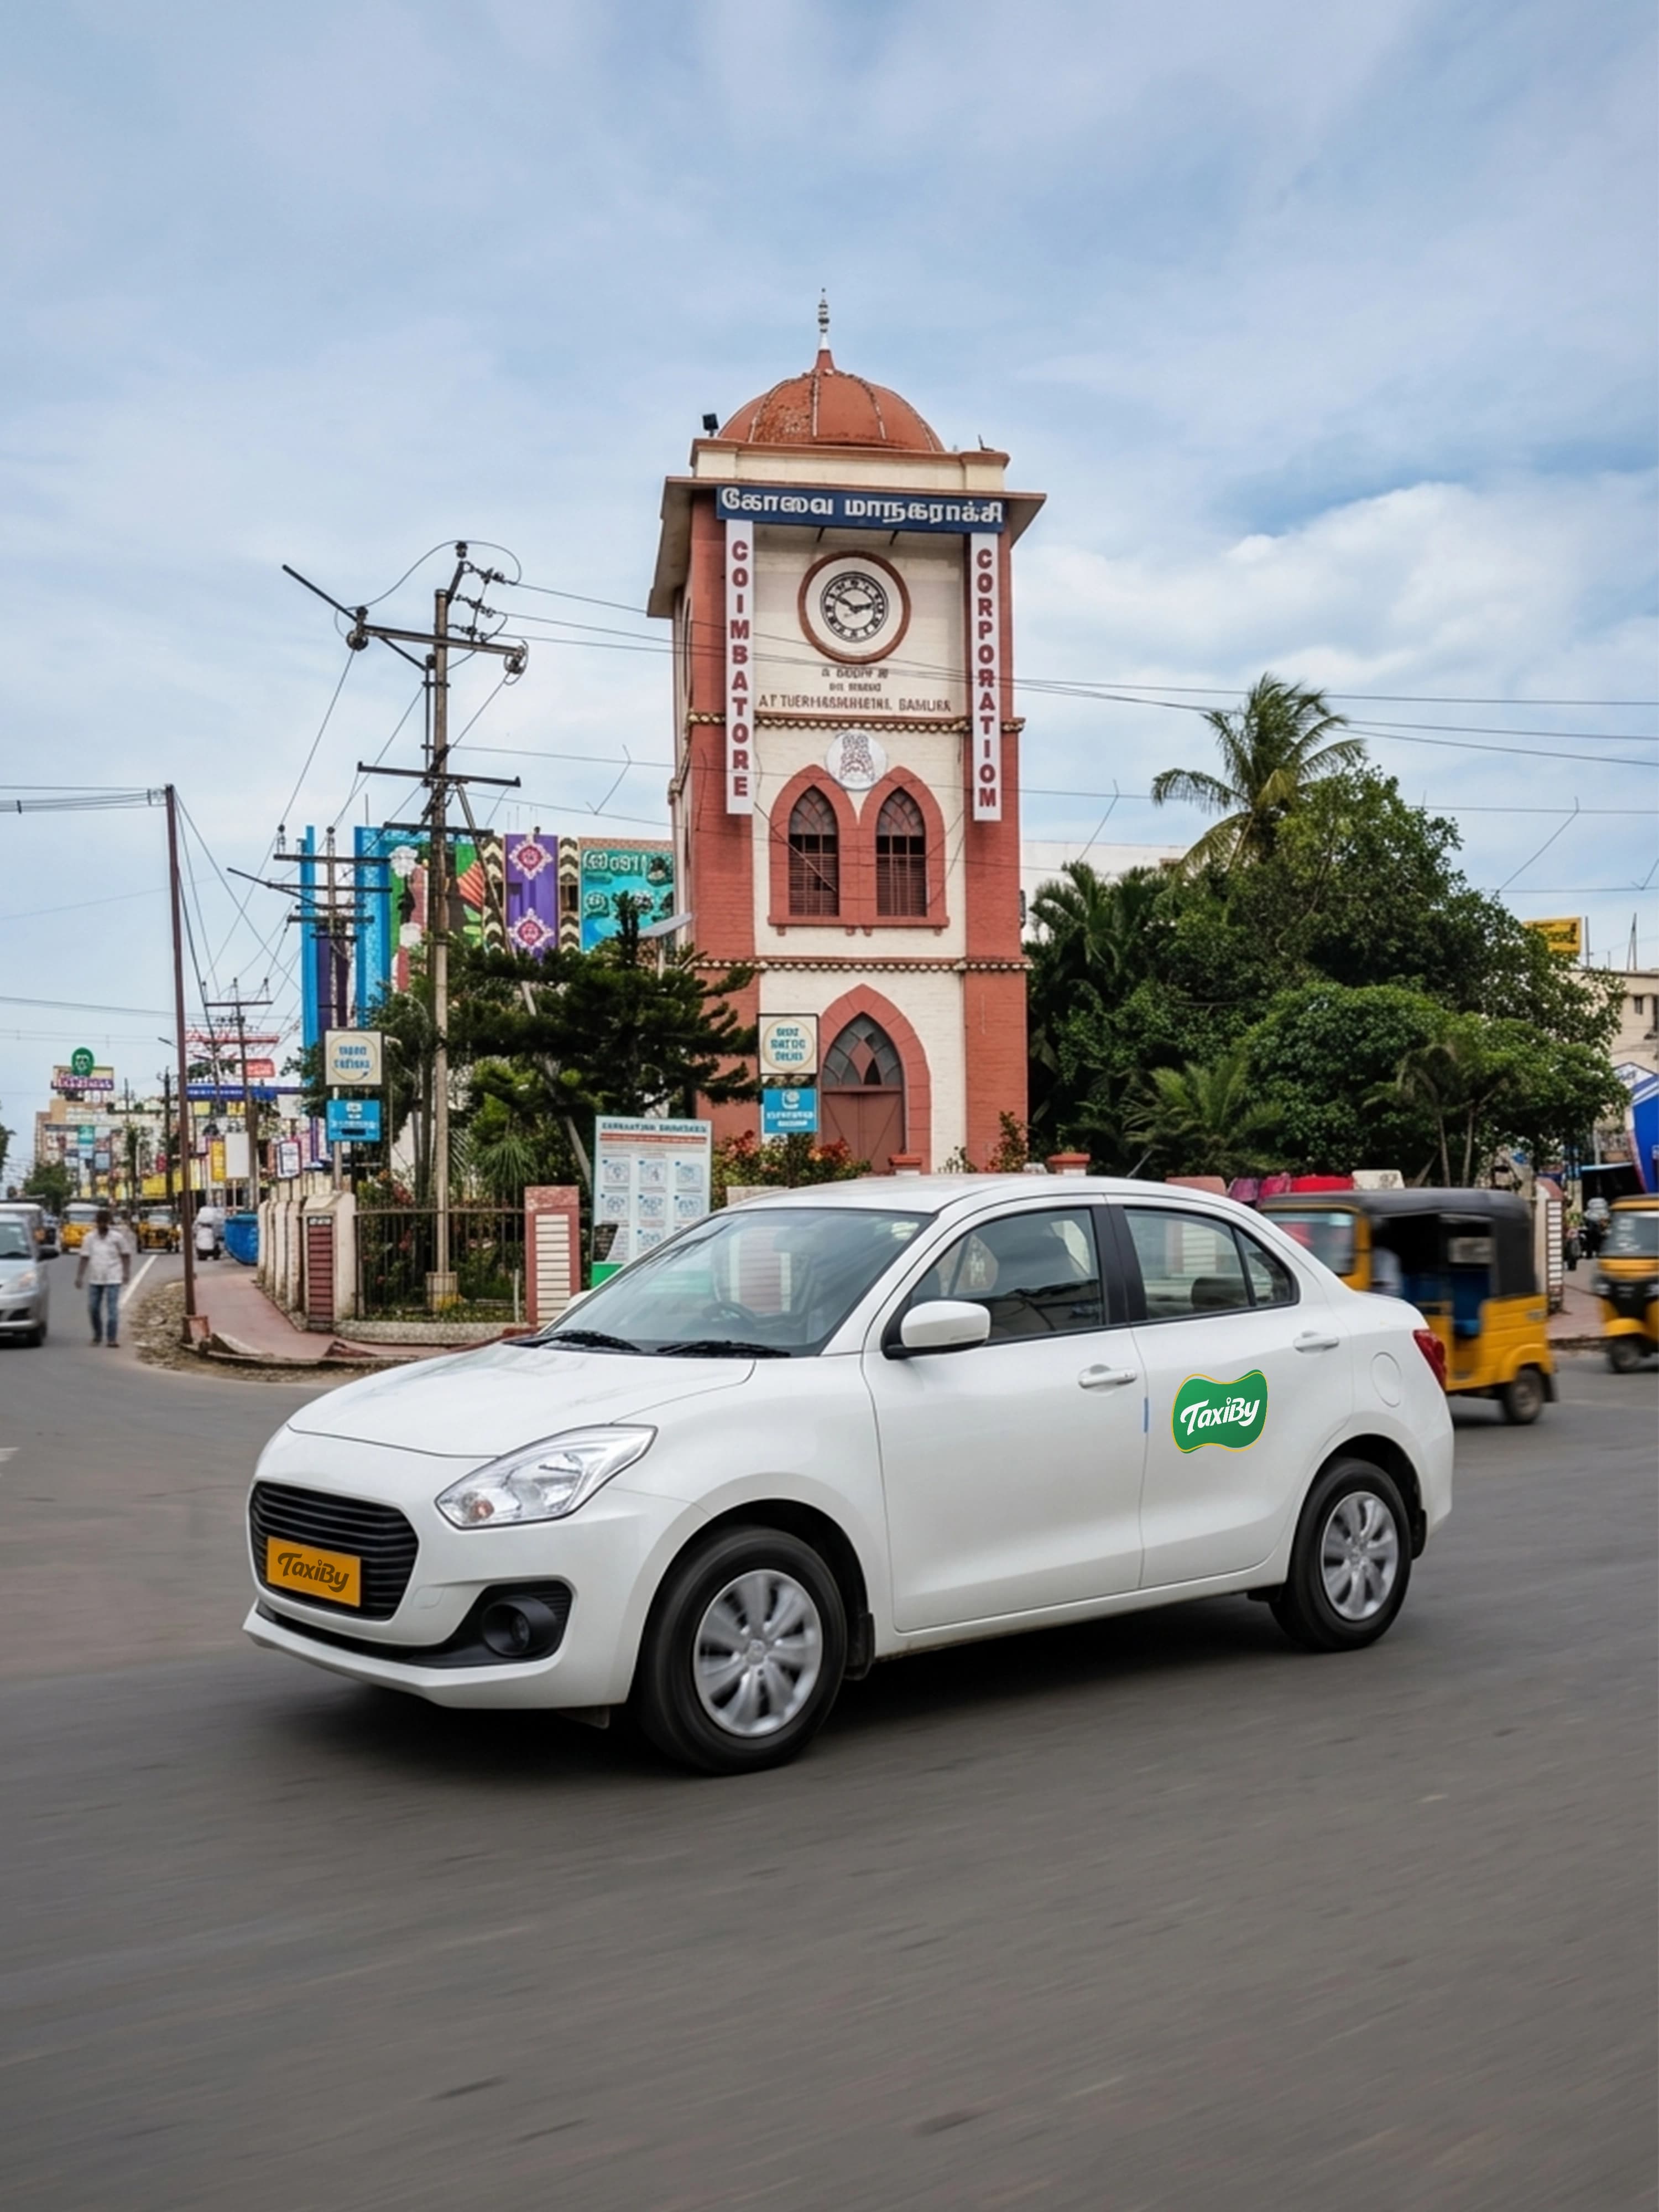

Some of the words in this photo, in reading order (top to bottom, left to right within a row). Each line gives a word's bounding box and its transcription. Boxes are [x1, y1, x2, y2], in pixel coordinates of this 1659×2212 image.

[730, 540, 749, 796] COIMBATORE
[1180, 1397, 1260, 1436] TaxiBy
[278, 1552, 349, 1593] TaxiBy
